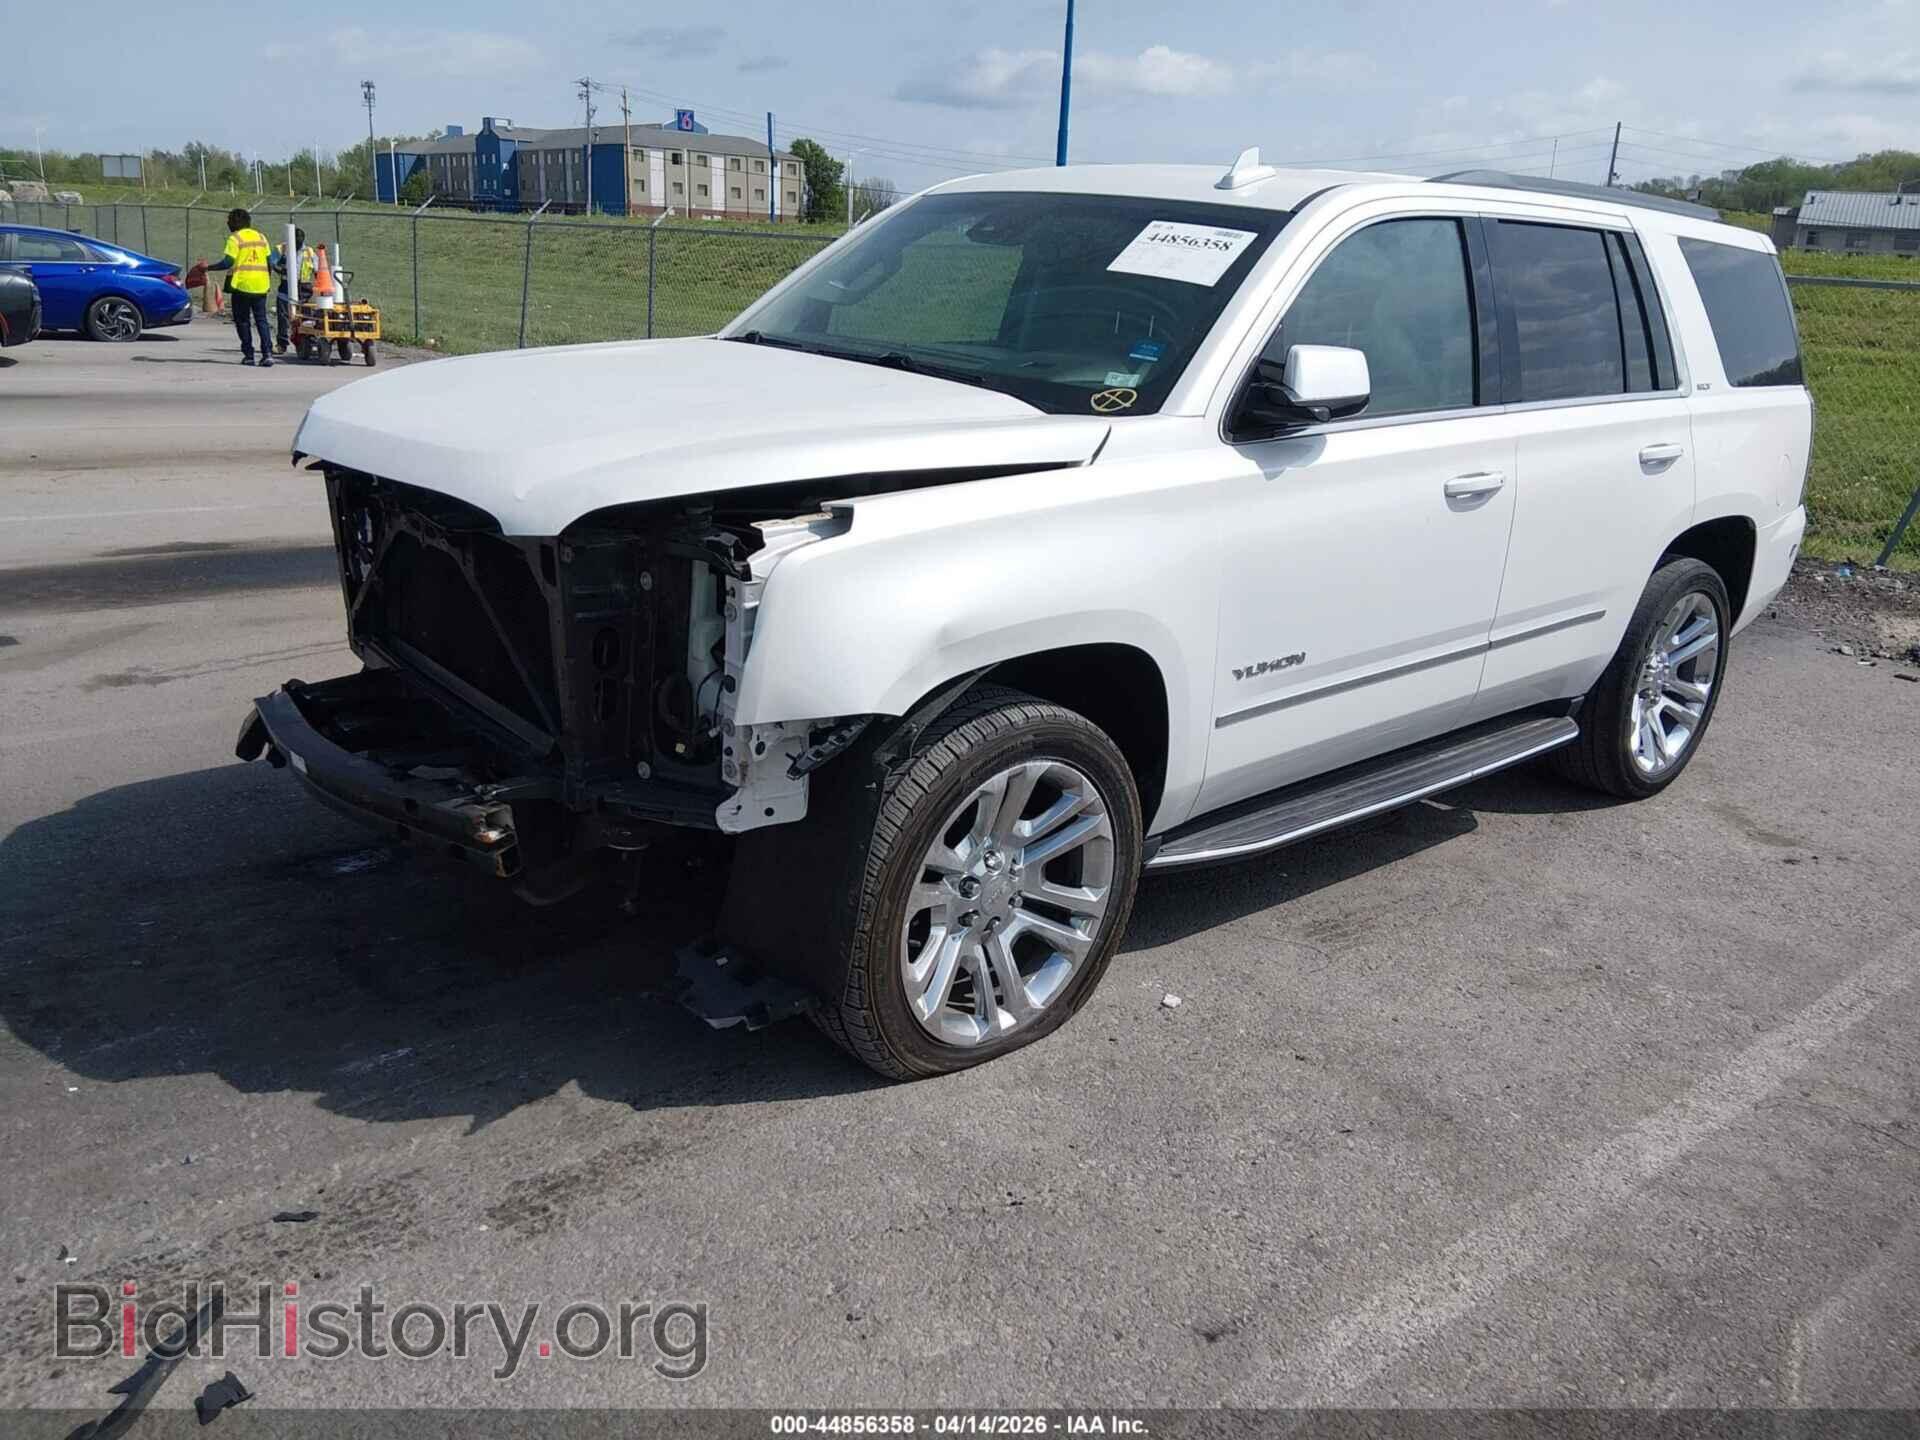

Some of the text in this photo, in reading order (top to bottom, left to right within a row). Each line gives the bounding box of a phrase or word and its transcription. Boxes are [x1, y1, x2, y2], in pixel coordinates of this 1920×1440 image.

[682, 112, 692, 130] 6
[1147, 232, 1234, 252] 44856358
[1232, 652, 1306, 681] YUKON
